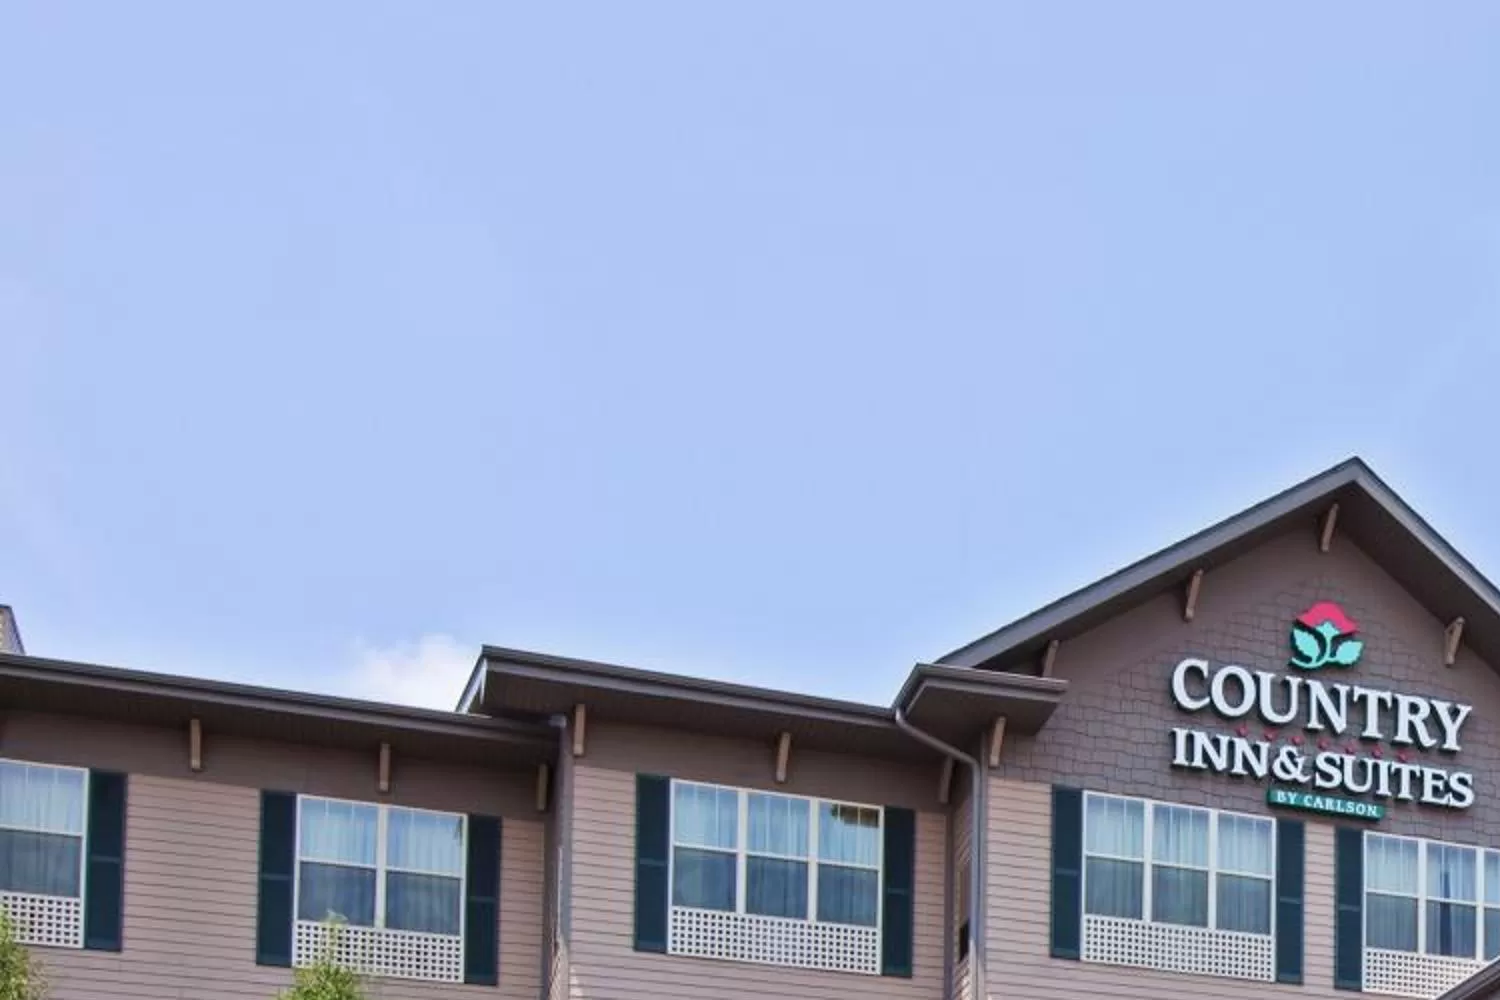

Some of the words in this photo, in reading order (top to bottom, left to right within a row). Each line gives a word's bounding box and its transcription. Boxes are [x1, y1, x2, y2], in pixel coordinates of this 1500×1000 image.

[1172, 658, 1473, 751] COUNTRY
[1277, 789, 1298, 804] BY
[1303, 794, 1379, 817] CARLSON
